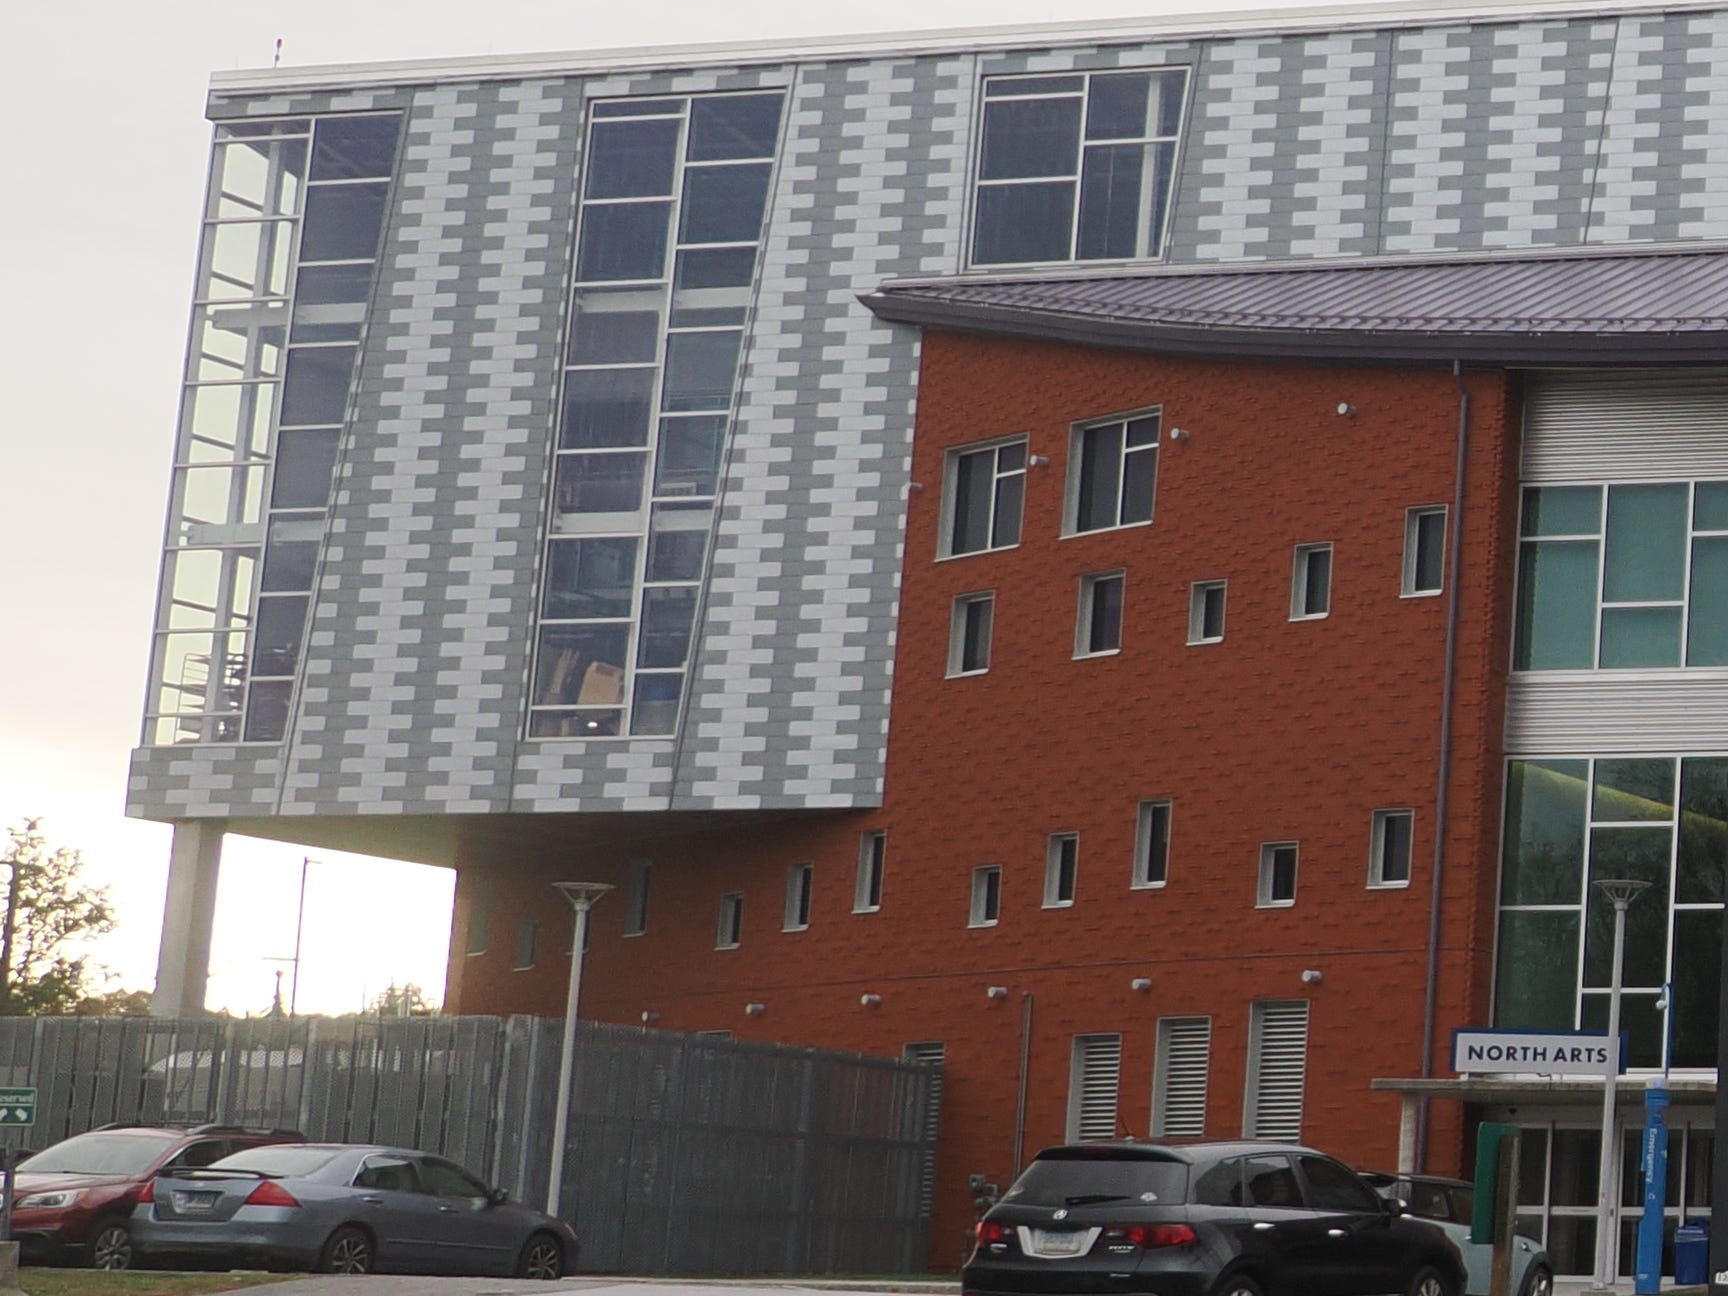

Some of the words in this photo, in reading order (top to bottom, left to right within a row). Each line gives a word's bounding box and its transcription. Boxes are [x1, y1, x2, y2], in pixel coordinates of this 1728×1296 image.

[1468, 1044, 1548, 1062] NORTH
[1553, 1046, 1608, 1064] ARTS
[0, 1093, 33, 1102] eserved
[1645, 1127, 1658, 1184] Emergency
